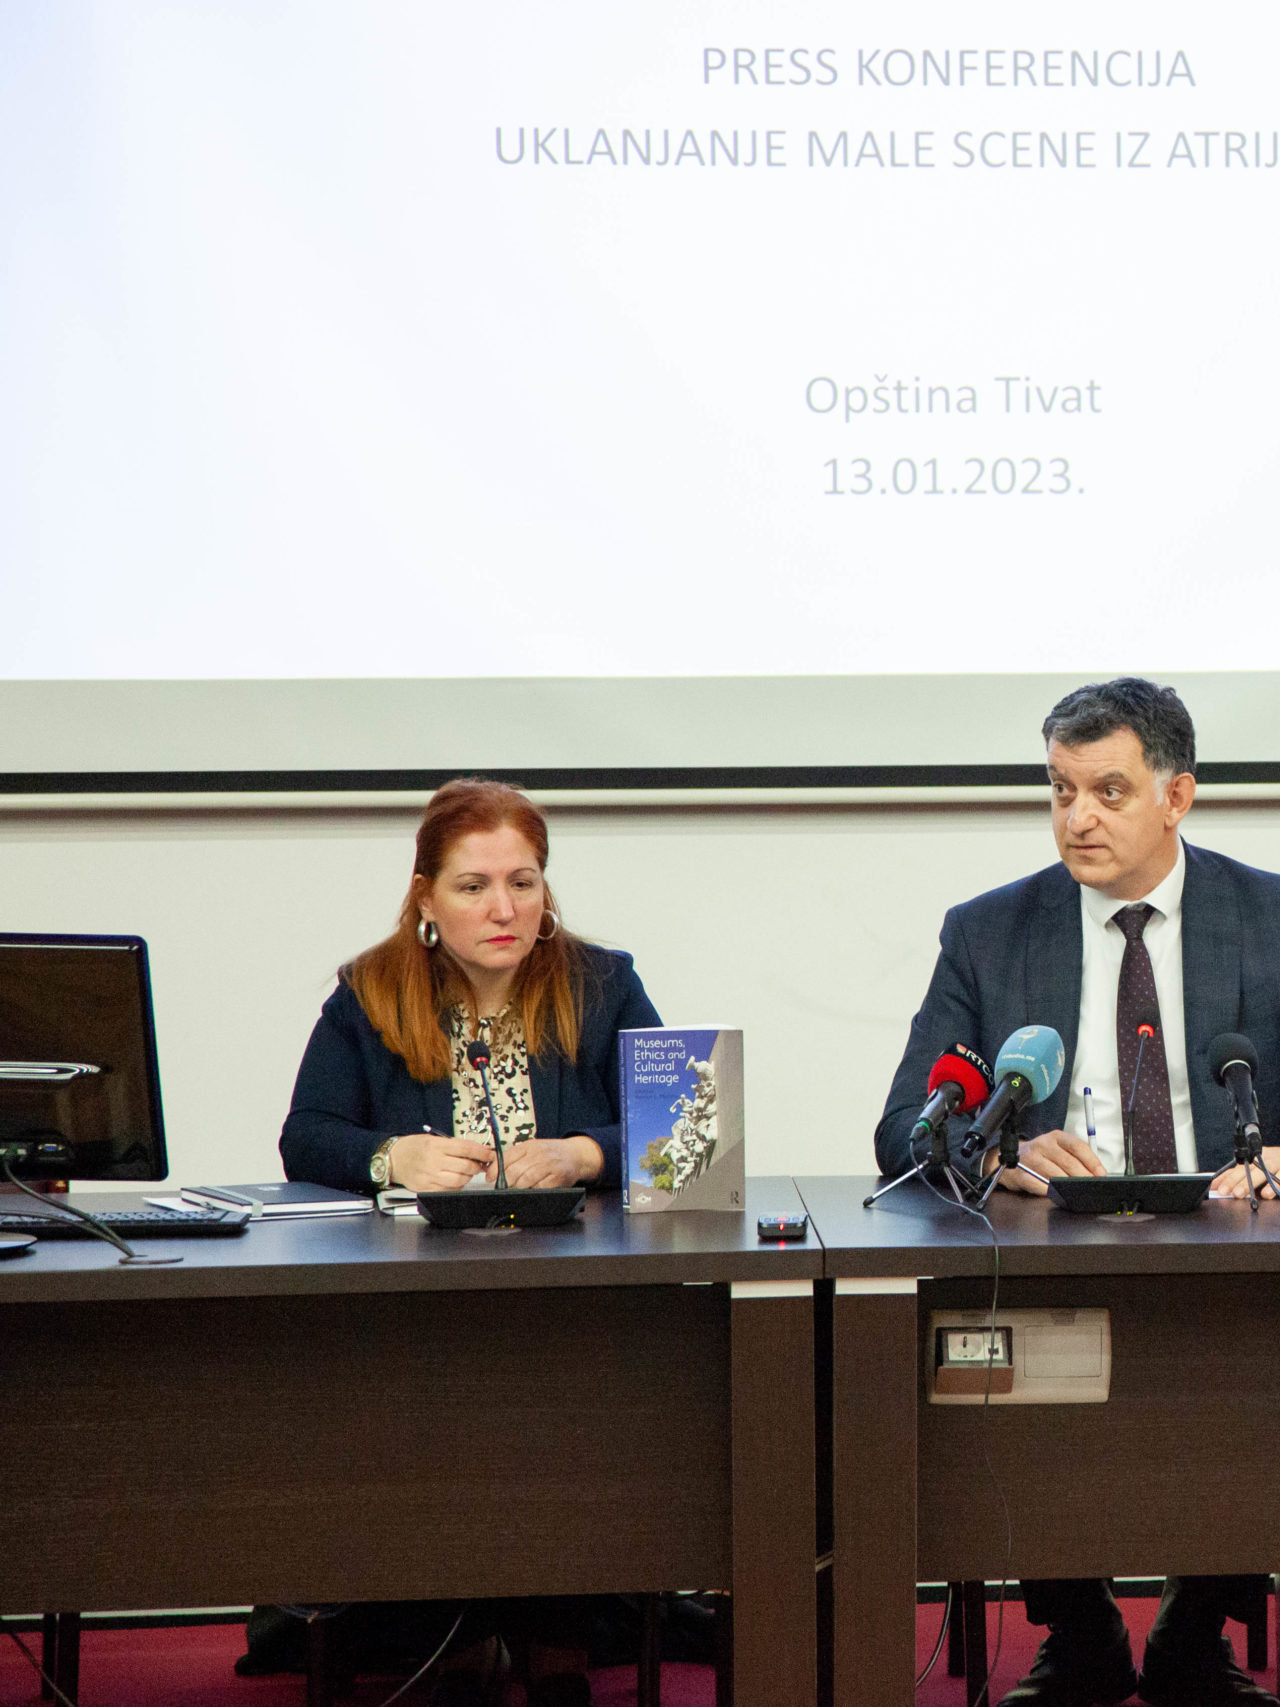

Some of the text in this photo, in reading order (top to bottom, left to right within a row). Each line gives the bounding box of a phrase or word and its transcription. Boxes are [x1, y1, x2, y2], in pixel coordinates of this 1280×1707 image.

[703, 47, 1197, 88] PRESS KONFERENCIJA
[495, 126, 787, 168] UKLANJANJE
[807, 130, 936, 168] MALE
[952, 130, 1097, 169] SCENE
[1115, 131, 1152, 169] IZ
[805, 374, 1102, 424] Opština Tivat
[822, 457, 1086, 496] 13.01.2023.
[634, 1049, 686, 1061] Ethics and
[634, 1060, 675, 1072] Cultural
[634, 1073, 680, 1087] Heritage
